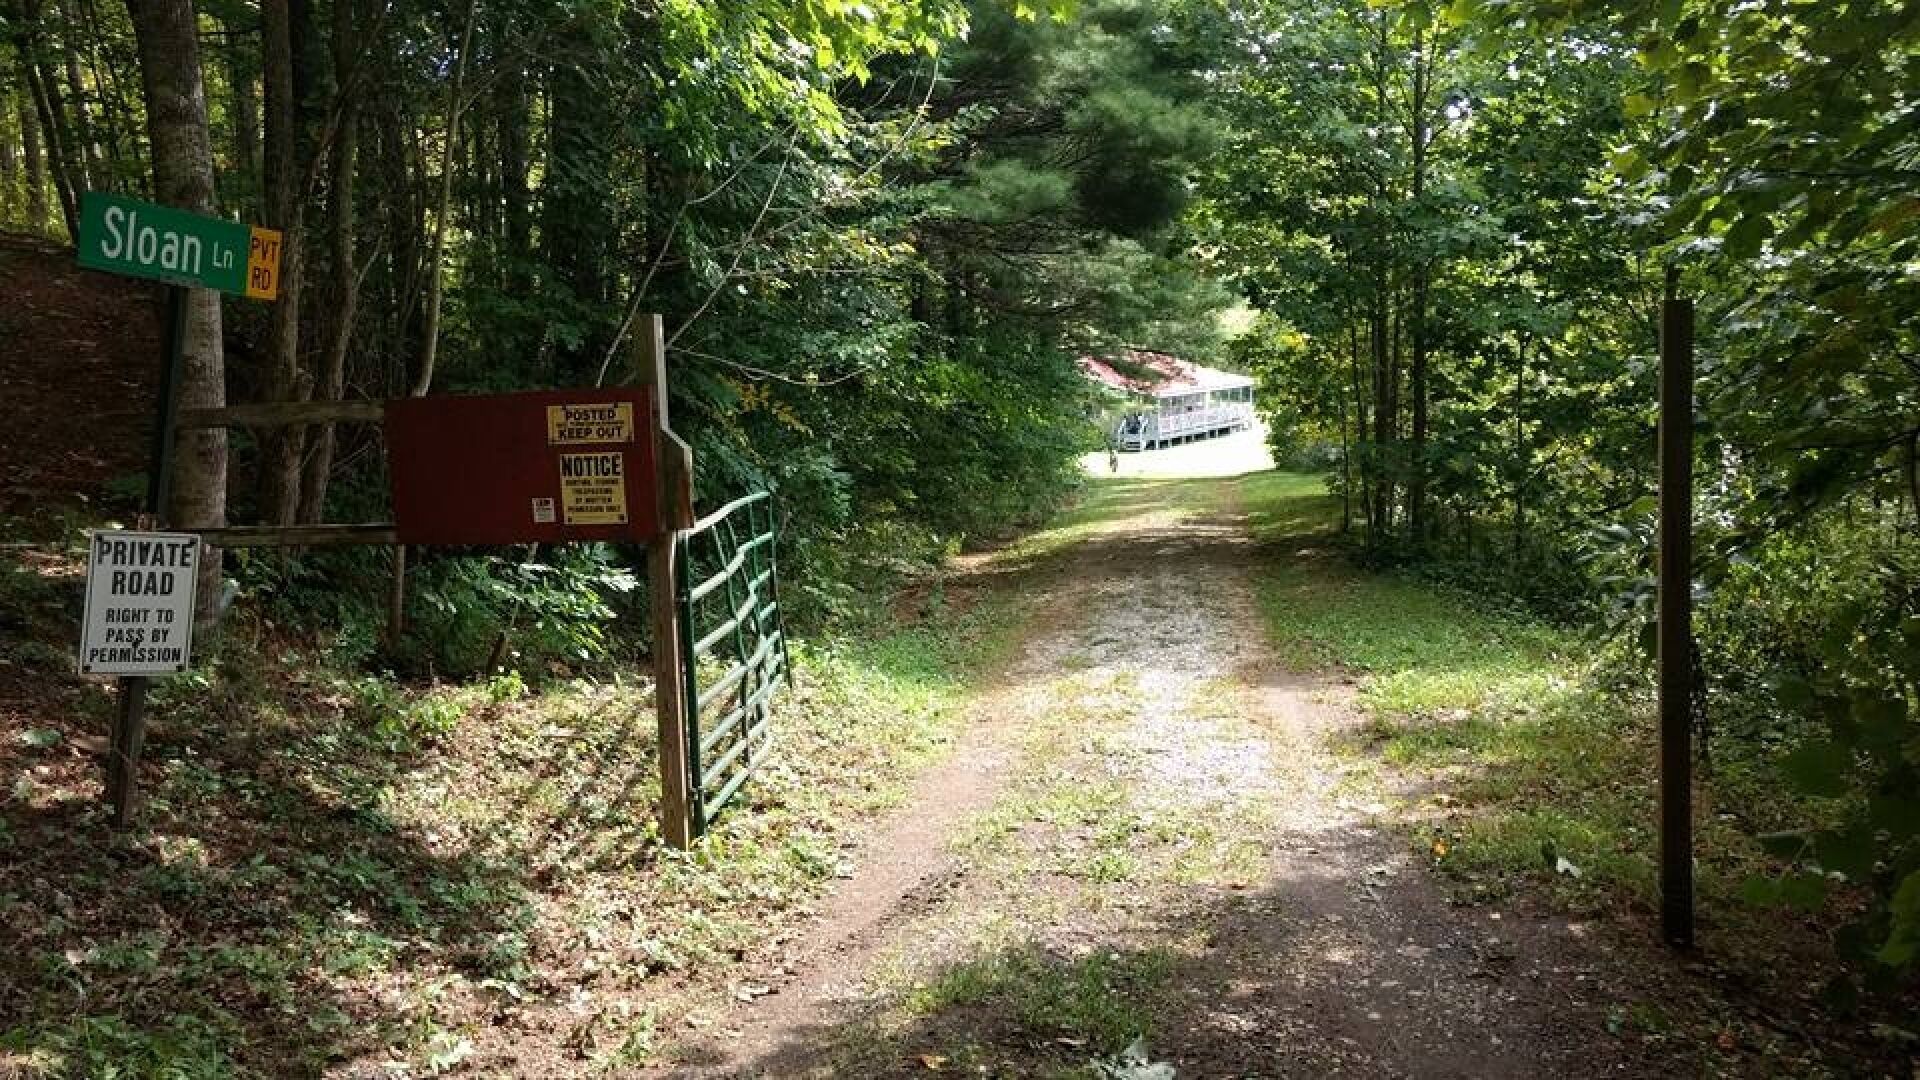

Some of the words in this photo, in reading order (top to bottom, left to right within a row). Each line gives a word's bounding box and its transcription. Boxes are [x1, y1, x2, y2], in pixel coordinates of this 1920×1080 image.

[101, 205, 201, 275] Sloan
[213, 241, 233, 269] Ln
[250, 236, 279, 263] PVT
[252, 266, 271, 290] RD
[566, 409, 616, 421] POSTED
[558, 427, 593, 440] KEEP
[596, 426, 623, 439] OUT
[561, 455, 621, 477] NOTICE
[97, 540, 196, 567] PRIVATE
[112, 571, 174, 595] ROAD
[105, 607, 150, 623] RIGHT
[156, 608, 175, 623] TO
[105, 627, 145, 643] PASS
[151, 627, 169, 643] BY
[89, 647, 181, 663] PERMISSION
